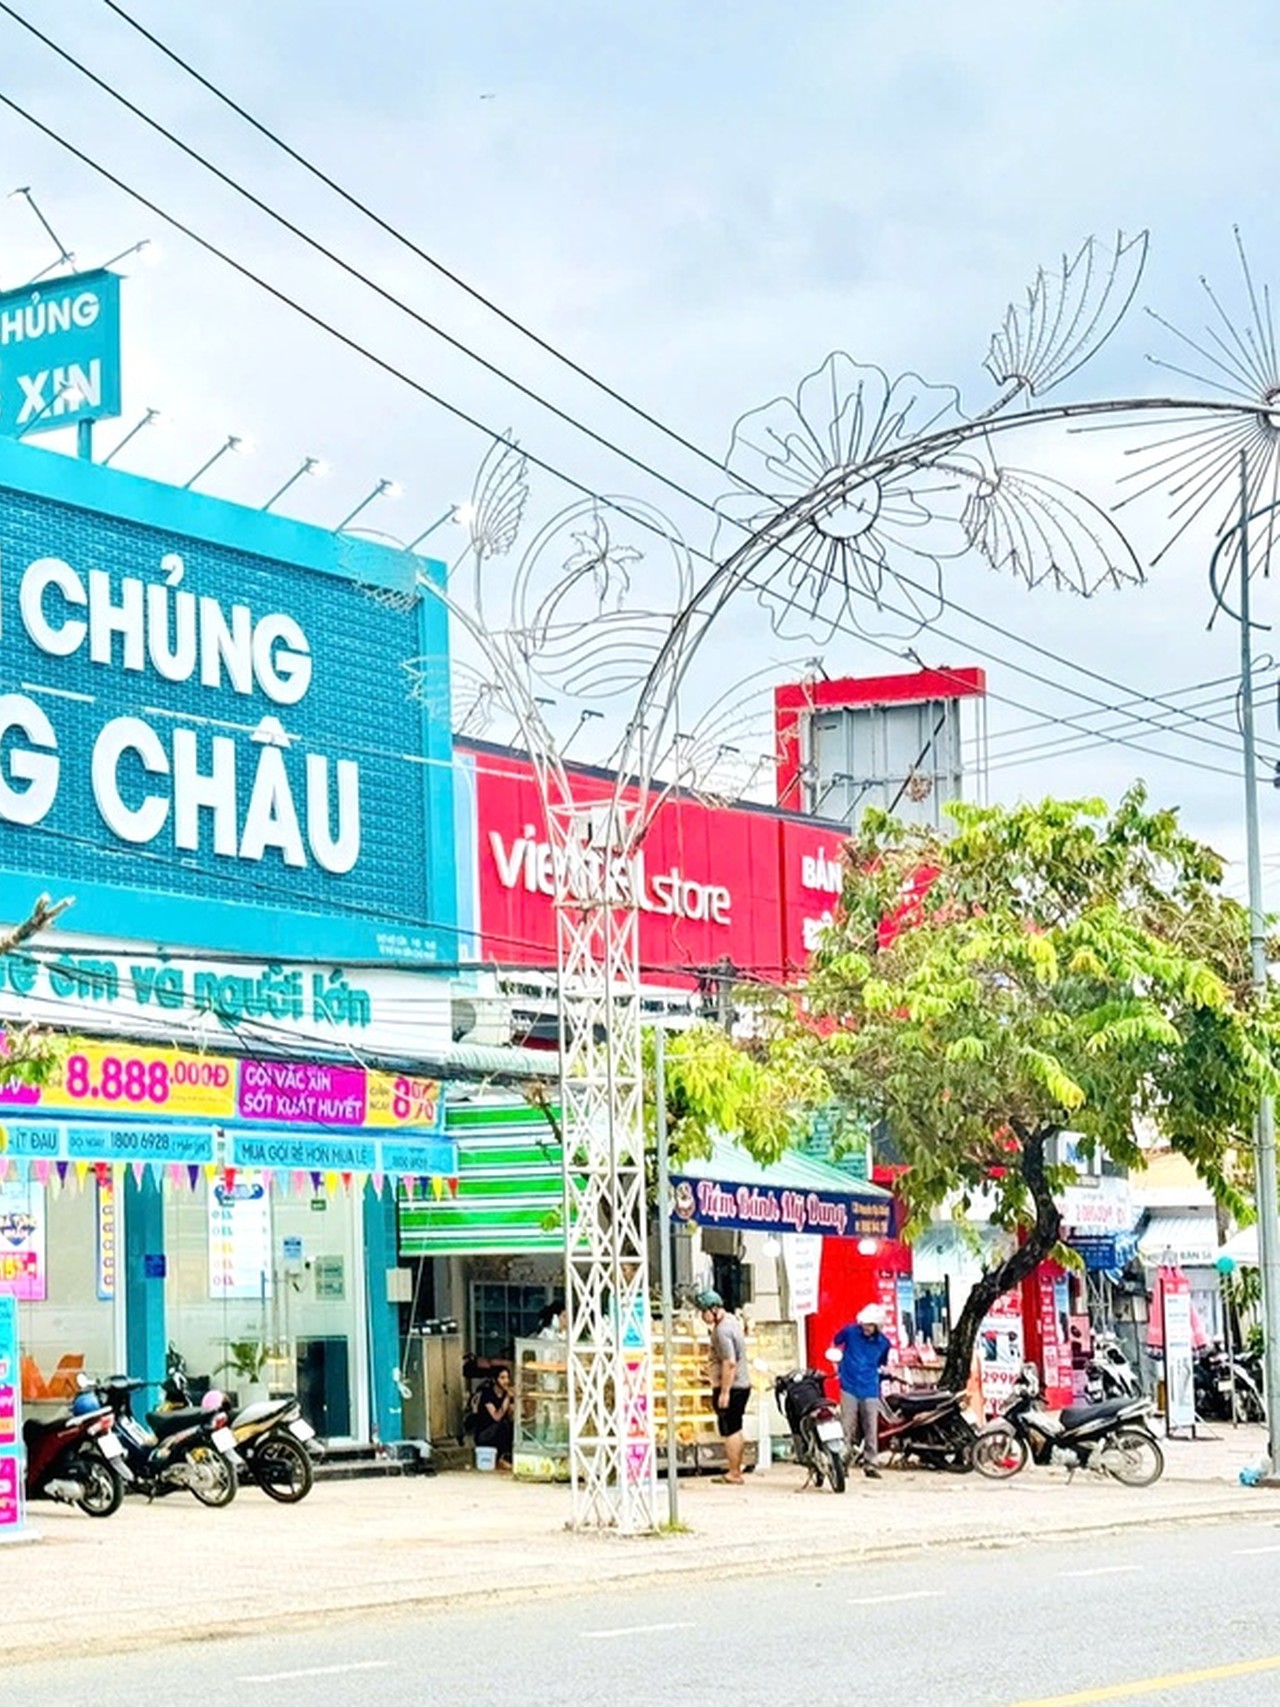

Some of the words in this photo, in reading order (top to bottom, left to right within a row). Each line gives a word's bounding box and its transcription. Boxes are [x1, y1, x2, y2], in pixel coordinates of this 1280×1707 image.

[16, 358, 101, 424] XIN
[20, 554, 313, 705] CHỦNG
[92, 715, 360, 875] CHÂU
[652, 867, 731, 925] store
[313, 967, 372, 1028] lớn
[243, 1088, 273, 1114] SỐT
[393, 1076, 434, 1121] 8%
[110, 1131, 138, 1149] 1800
[140, 1132, 170, 1150] 6928
